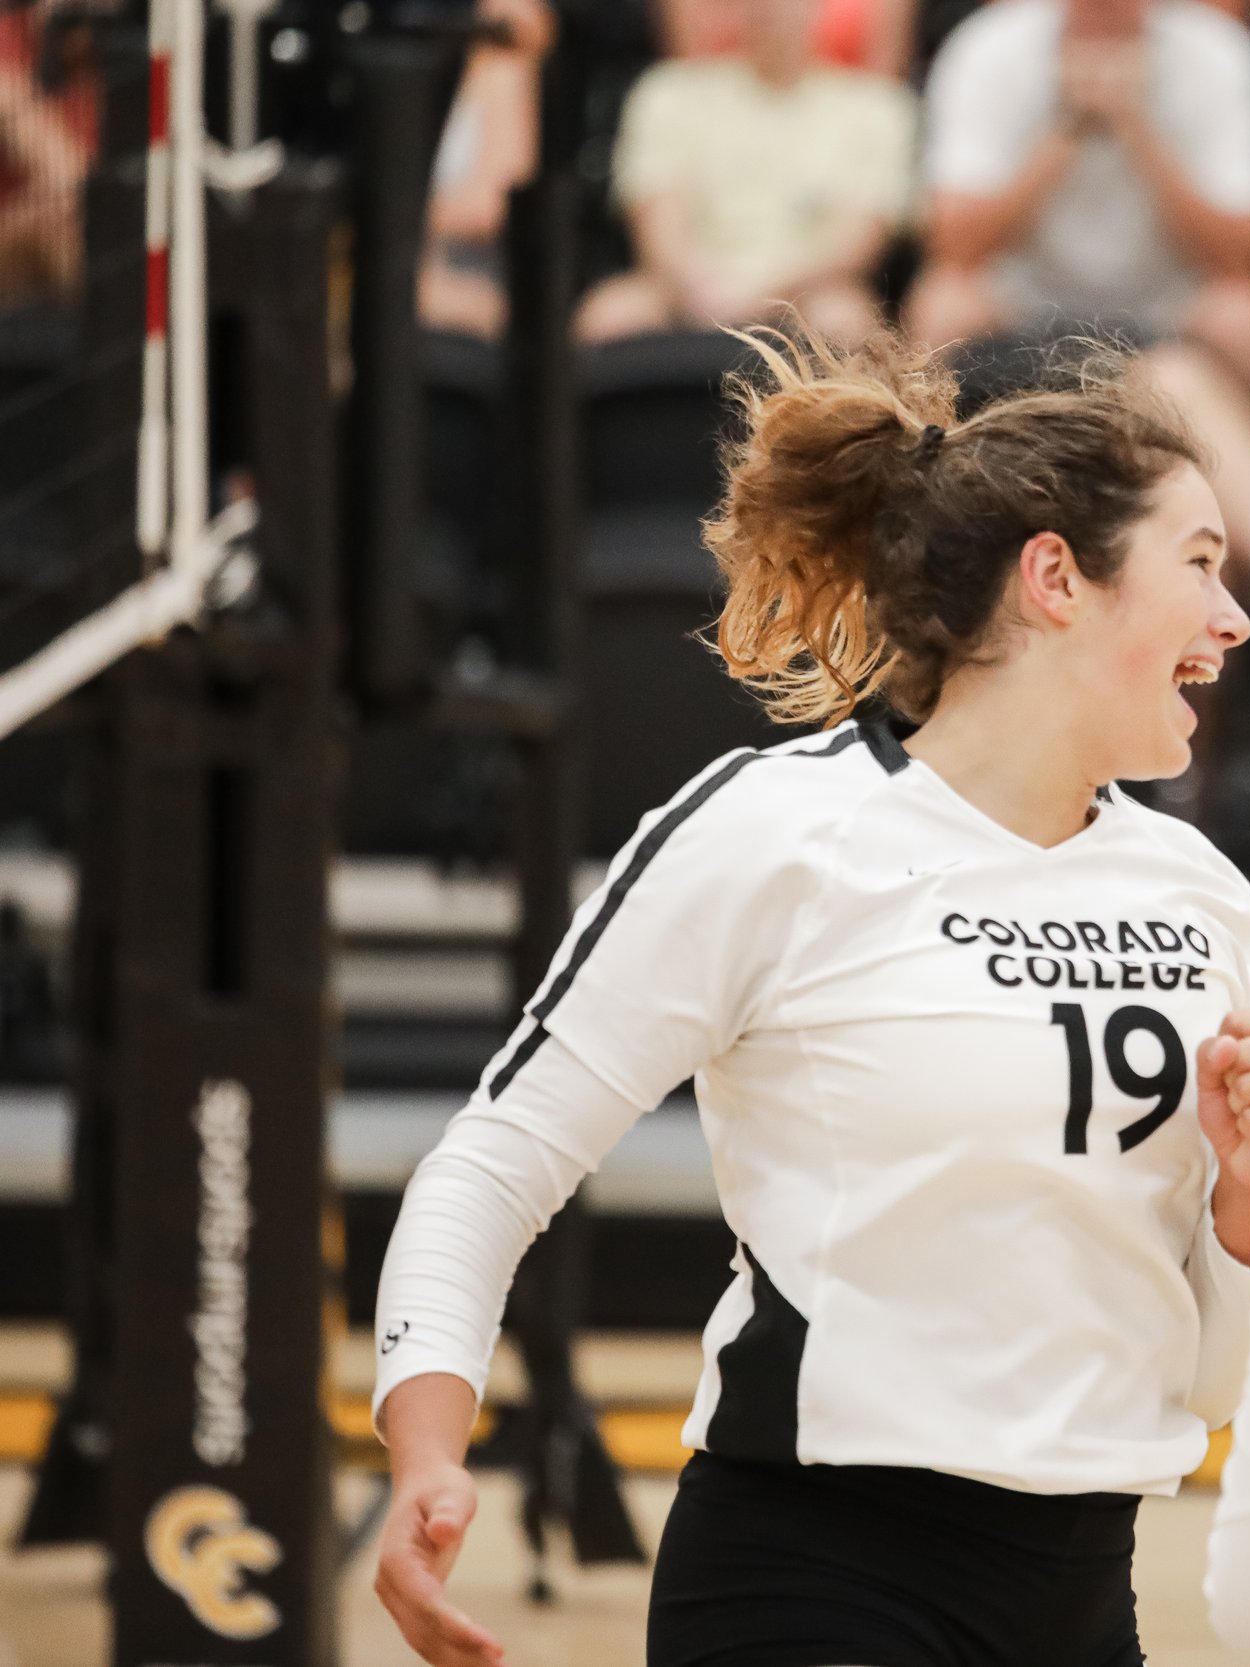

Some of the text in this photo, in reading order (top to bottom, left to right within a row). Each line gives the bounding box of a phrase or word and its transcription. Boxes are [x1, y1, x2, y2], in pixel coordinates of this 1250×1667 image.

[941, 913, 1211, 959] COLORADO
[988, 954, 1207, 990] COLLEGE
[1051, 1003, 1187, 1155] 19
